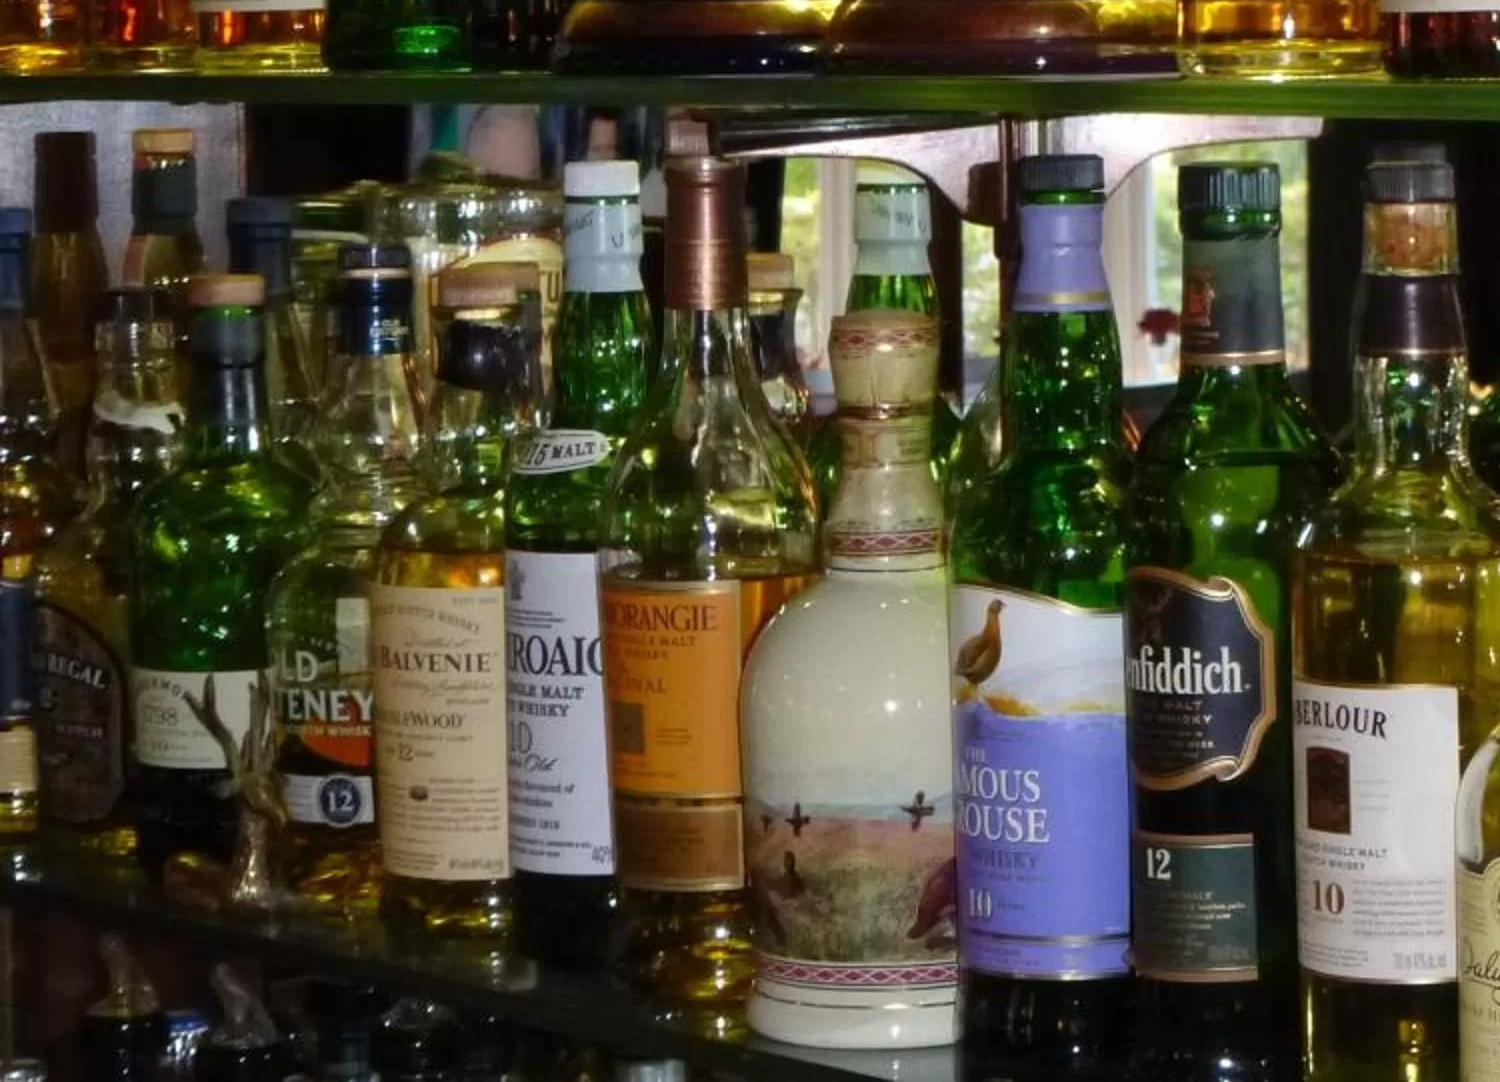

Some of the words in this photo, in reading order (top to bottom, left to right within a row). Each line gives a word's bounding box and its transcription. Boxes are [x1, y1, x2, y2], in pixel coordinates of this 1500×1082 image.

[552, 440, 597, 459] MALT
[48, 653, 106, 689] REGAL
[380, 645, 491, 673] BALVENIE
[541, 685, 585, 700] MALT
[328, 791, 354, 812] 12
[1146, 846, 1172, 879] 12
[968, 887, 994, 918] 10
[1312, 879, 1346, 915] 10
